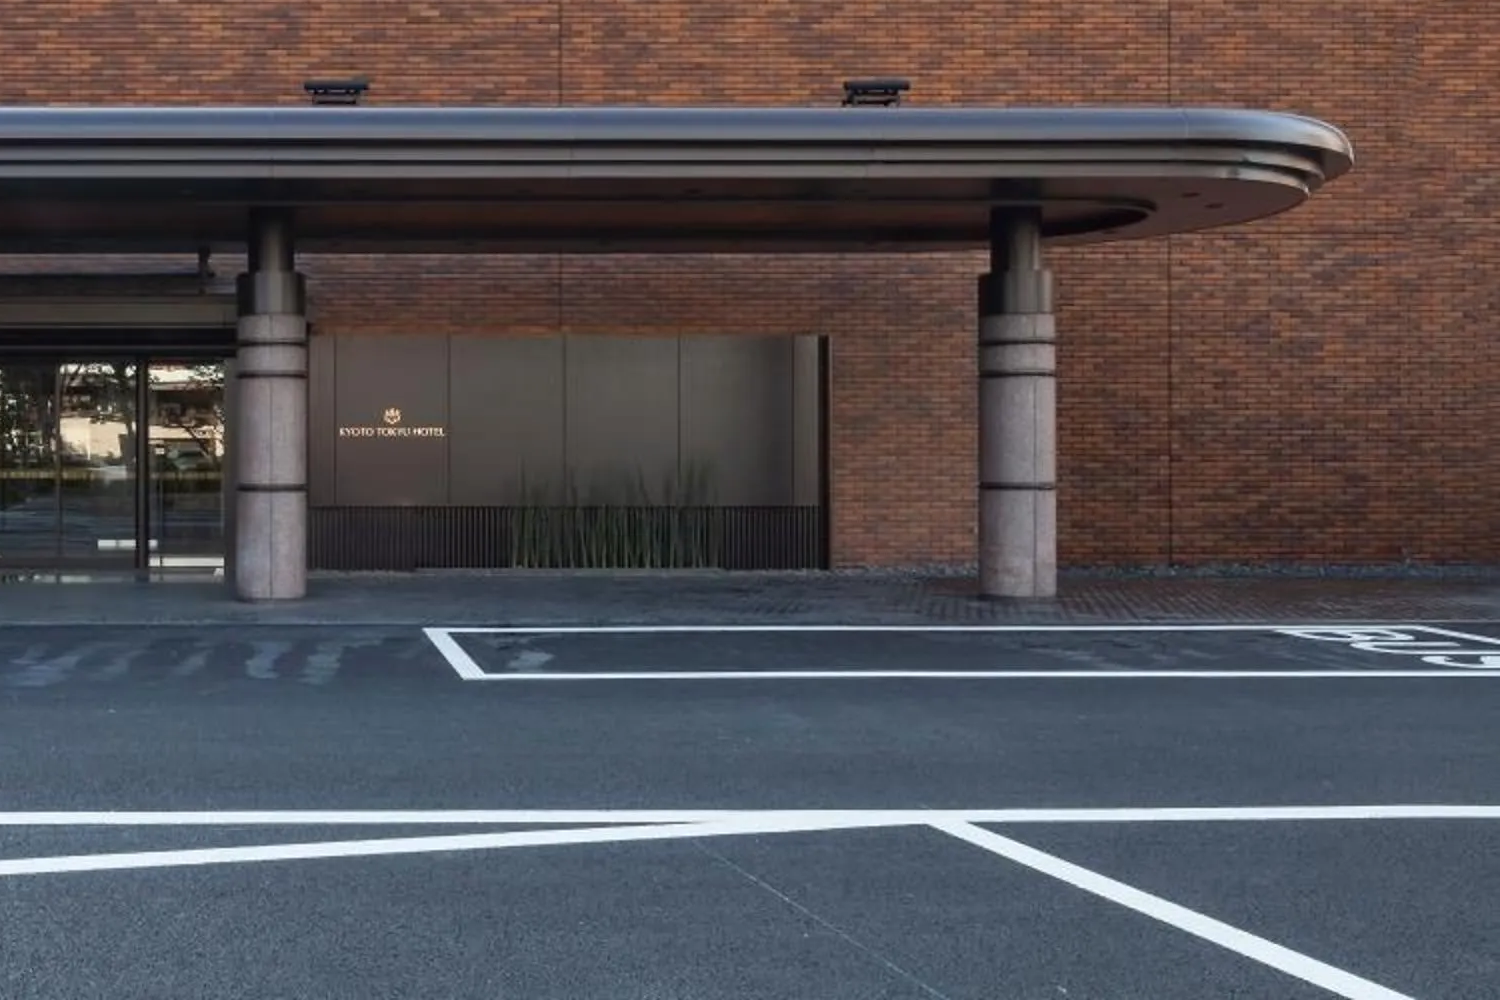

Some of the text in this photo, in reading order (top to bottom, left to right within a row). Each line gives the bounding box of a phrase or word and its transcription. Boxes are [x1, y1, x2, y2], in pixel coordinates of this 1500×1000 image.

[339, 427, 445, 437] KYOTO TOKYU HOTEL
